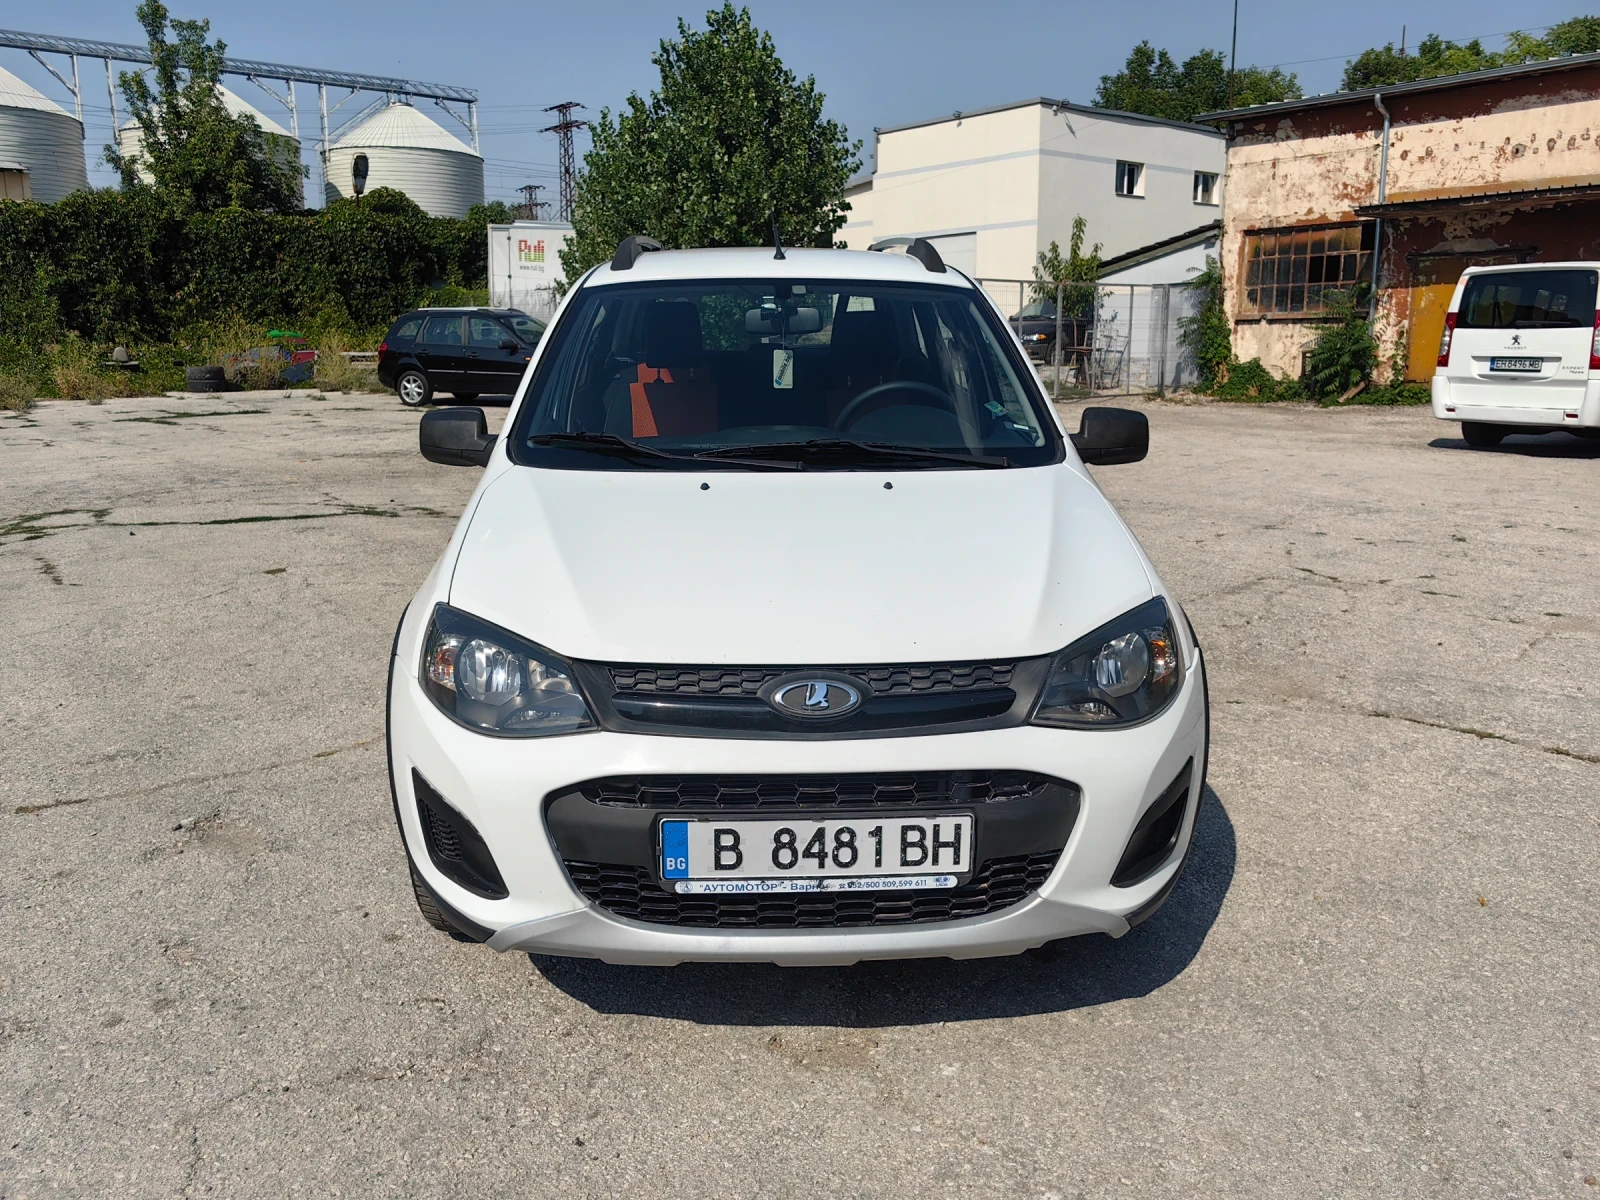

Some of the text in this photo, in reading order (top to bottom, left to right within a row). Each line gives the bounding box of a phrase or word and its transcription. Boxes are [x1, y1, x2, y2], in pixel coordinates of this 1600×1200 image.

[713, 823, 962, 871] B 8481 BH
[665, 857, 687, 871] BG
[915, 879, 927, 887] 611
